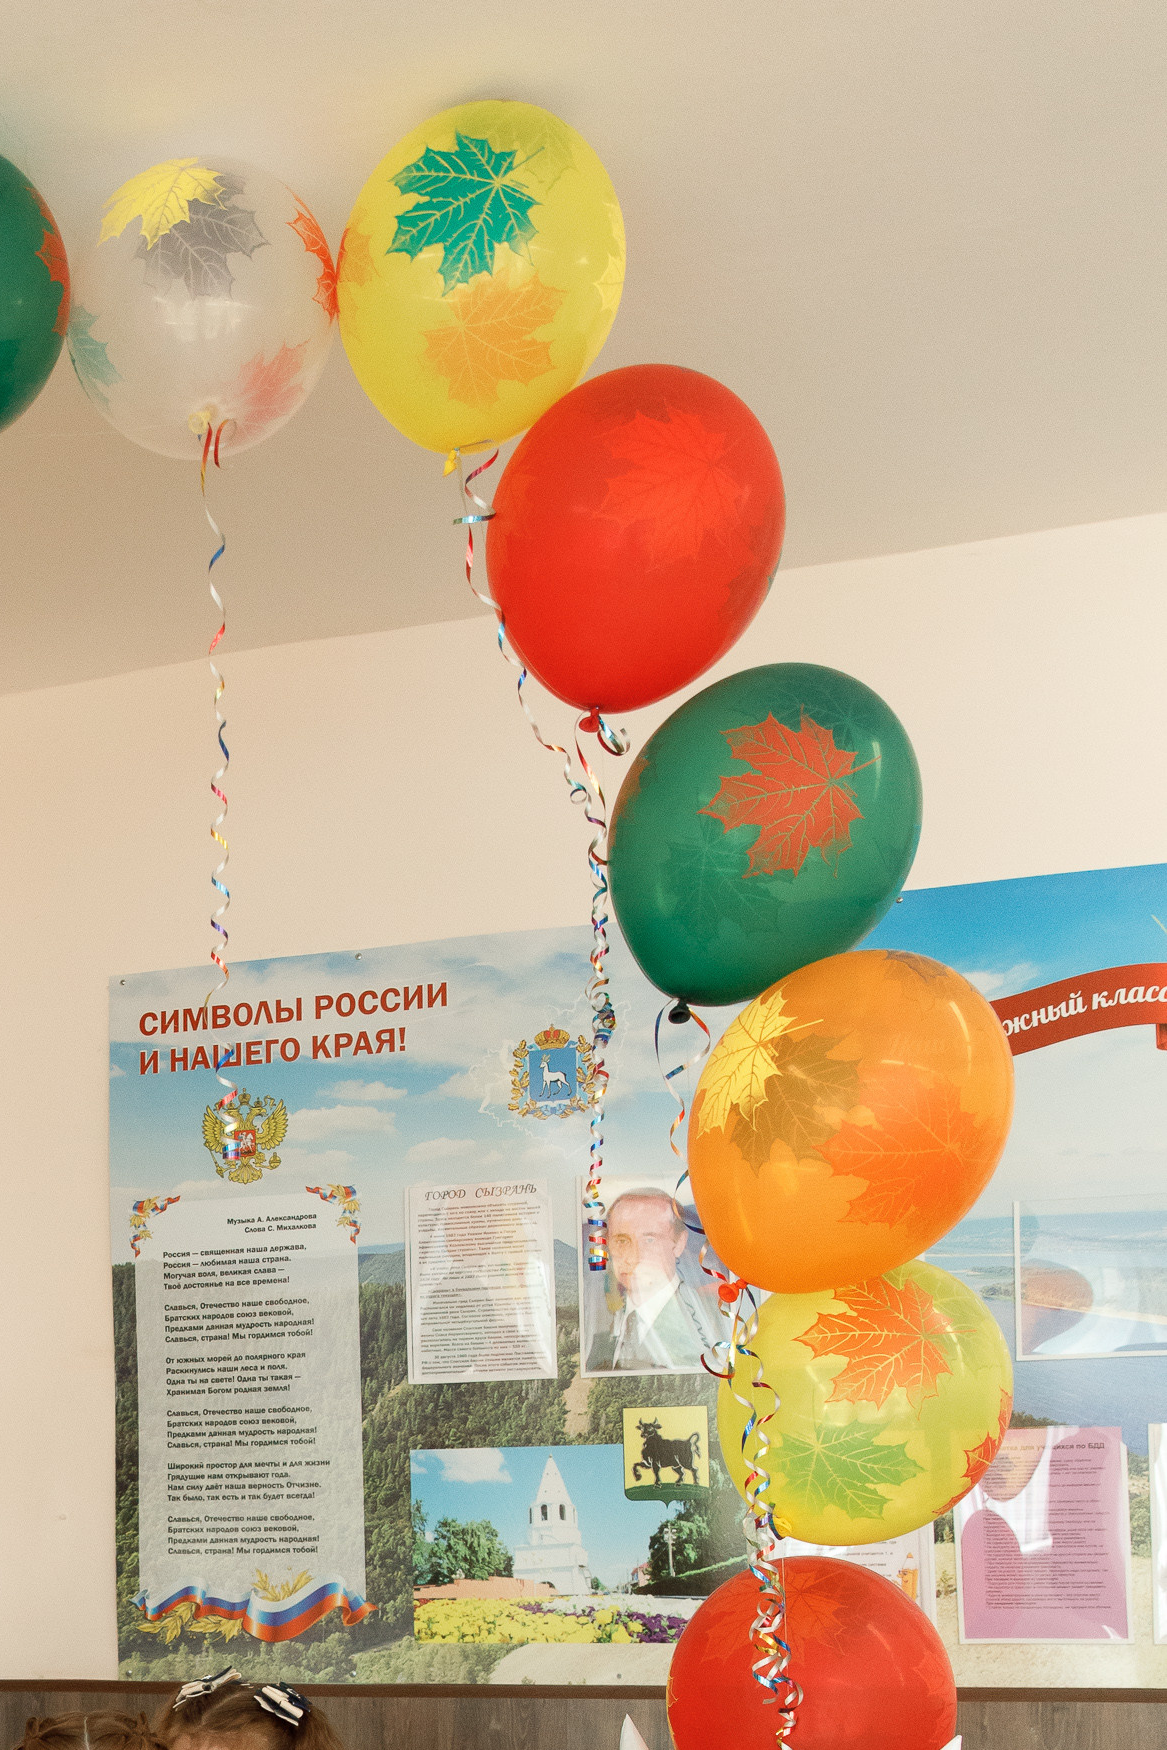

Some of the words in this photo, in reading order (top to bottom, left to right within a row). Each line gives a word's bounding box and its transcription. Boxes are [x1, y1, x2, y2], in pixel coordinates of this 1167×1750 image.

[139, 997, 302, 1036] СИМВОЛЫ
[316, 982, 448, 1019] РОССИИ
[139, 1050, 159, 1075] И
[170, 1037, 300, 1073] НАШЕГО
[312, 1027, 406, 1060] КРАЯ!
[424, 1190, 466, 1201] ГОРОД
[475, 1184, 537, 1198] СЫЗРАНЬ
[266, 1213, 317, 1222] Александрова
[277, 1223, 316, 1231] Михалкова
[201, 1248, 244, 1256] священная
[270, 1244, 306, 1252] держава,
[200, 1258, 236, 1267] любимая
[262, 1256, 291, 1264] страна.
[164, 1272, 196, 1280] Могучая
[198, 1270, 218, 1278] воля,
[183, 1281, 222, 1290] достоянье
[253, 1276, 290, 1285] времена!
[200, 1302, 239, 1310] Отечество
[165, 1314, 200, 1322] Братских
[259, 1309, 294, 1317] вековой,
[165, 1325, 203, 1333] Предками
[236, 1321, 272, 1329] мудрость
[274, 1318, 314, 1327] народная!
[165, 1335, 199, 1343] Славься,
[201, 1333, 230, 1341] страна!
[248, 1331, 285, 1339] гордимся
[288, 1329, 313, 1337] тобой!
[207, 1354, 232, 1363] морей
[245, 1353, 285, 1361] полярного
[166, 1367, 215, 1375] Раскинулись
[211, 1375, 234, 1383] свете!
[237, 1375, 256, 1383] Одна
[167, 1388, 205, 1396] Хранимая
[234, 1386, 261, 1394] родная
[264, 1384, 290, 1392] земля!
[205, 1419, 236, 1427] народов
[262, 1416, 297, 1424] вековой,
[239, 1429, 275, 1437] мудрость
[277, 1427, 317, 1435] народная!
[168, 1441, 201, 1449] Славься,
[168, 1462, 203, 1470] Широкий
[225, 1472, 269, 1480] открывают
[205, 1482, 222, 1490] даёт
[248, 1482, 284, 1490] верность
[263, 1492, 284, 1500] будет
[286, 1491, 315, 1499] всегда!
